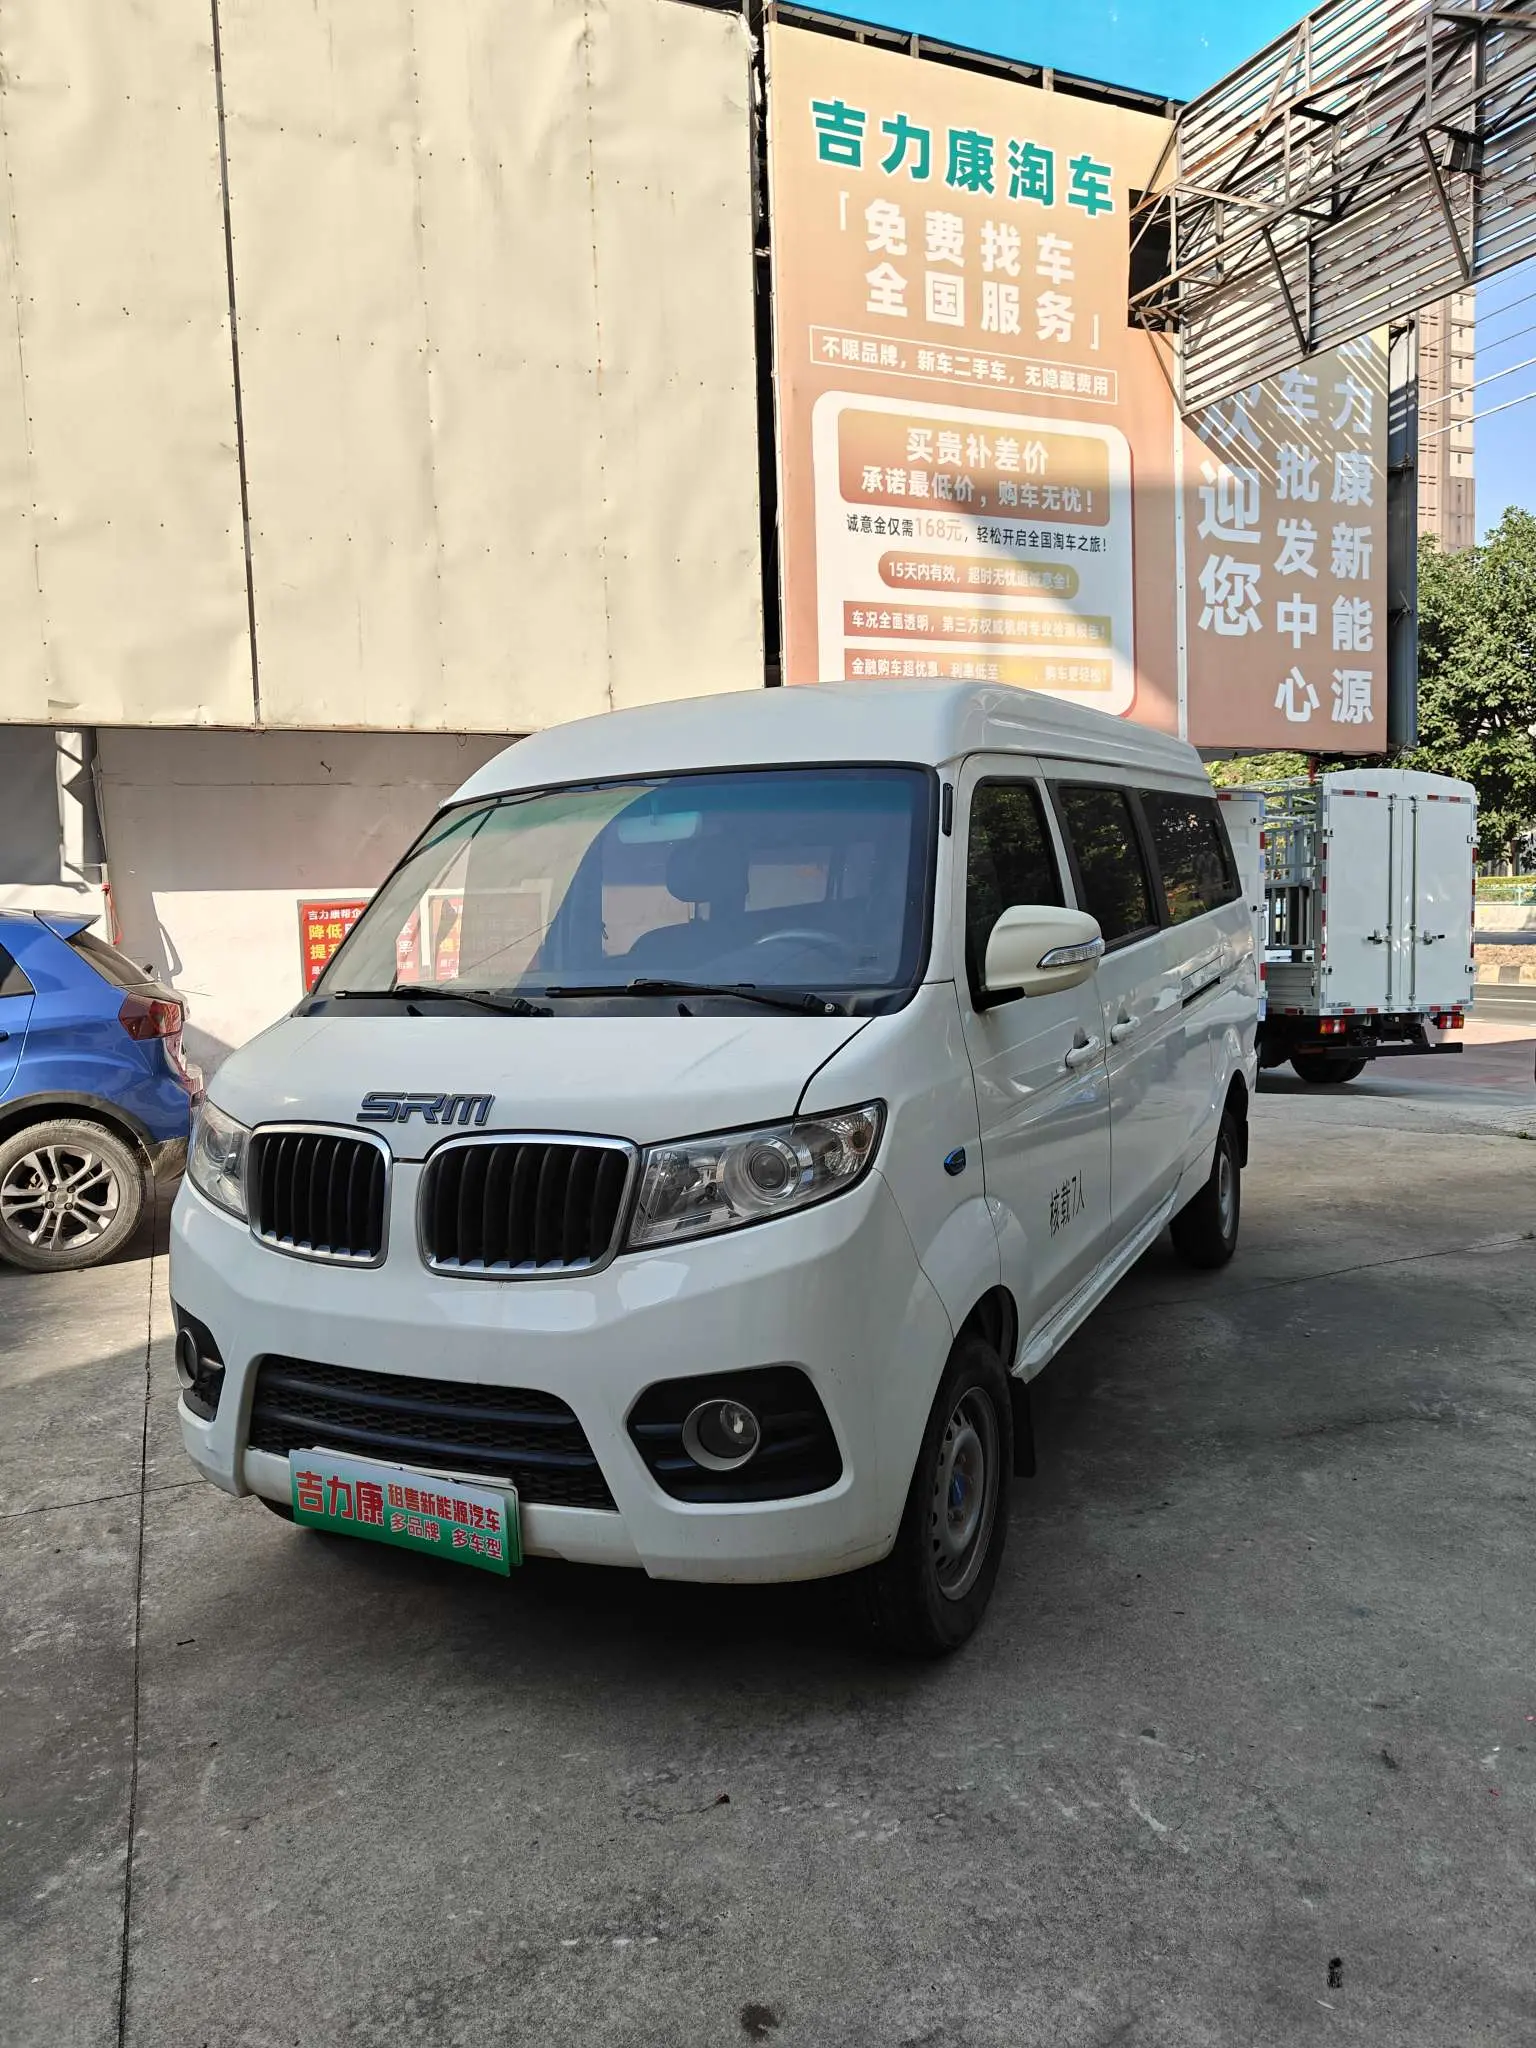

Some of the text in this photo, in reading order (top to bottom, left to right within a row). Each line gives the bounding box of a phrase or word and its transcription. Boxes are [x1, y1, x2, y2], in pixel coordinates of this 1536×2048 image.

[811, 98, 1115, 216] 吉力康淘车
[906, 427, 1049, 476] 买贵补差价
[860, 465, 1093, 513] 承诺最低价，购车无忧！
[1274, 367, 1320, 723] 车批发中心
[356, 1091, 496, 1126] SRM
[295, 1470, 384, 1526] 吉力康
[387, 1483, 502, 1533] 租售新能源汽车
[390, 1512, 503, 1560] 多品牌 多车型
